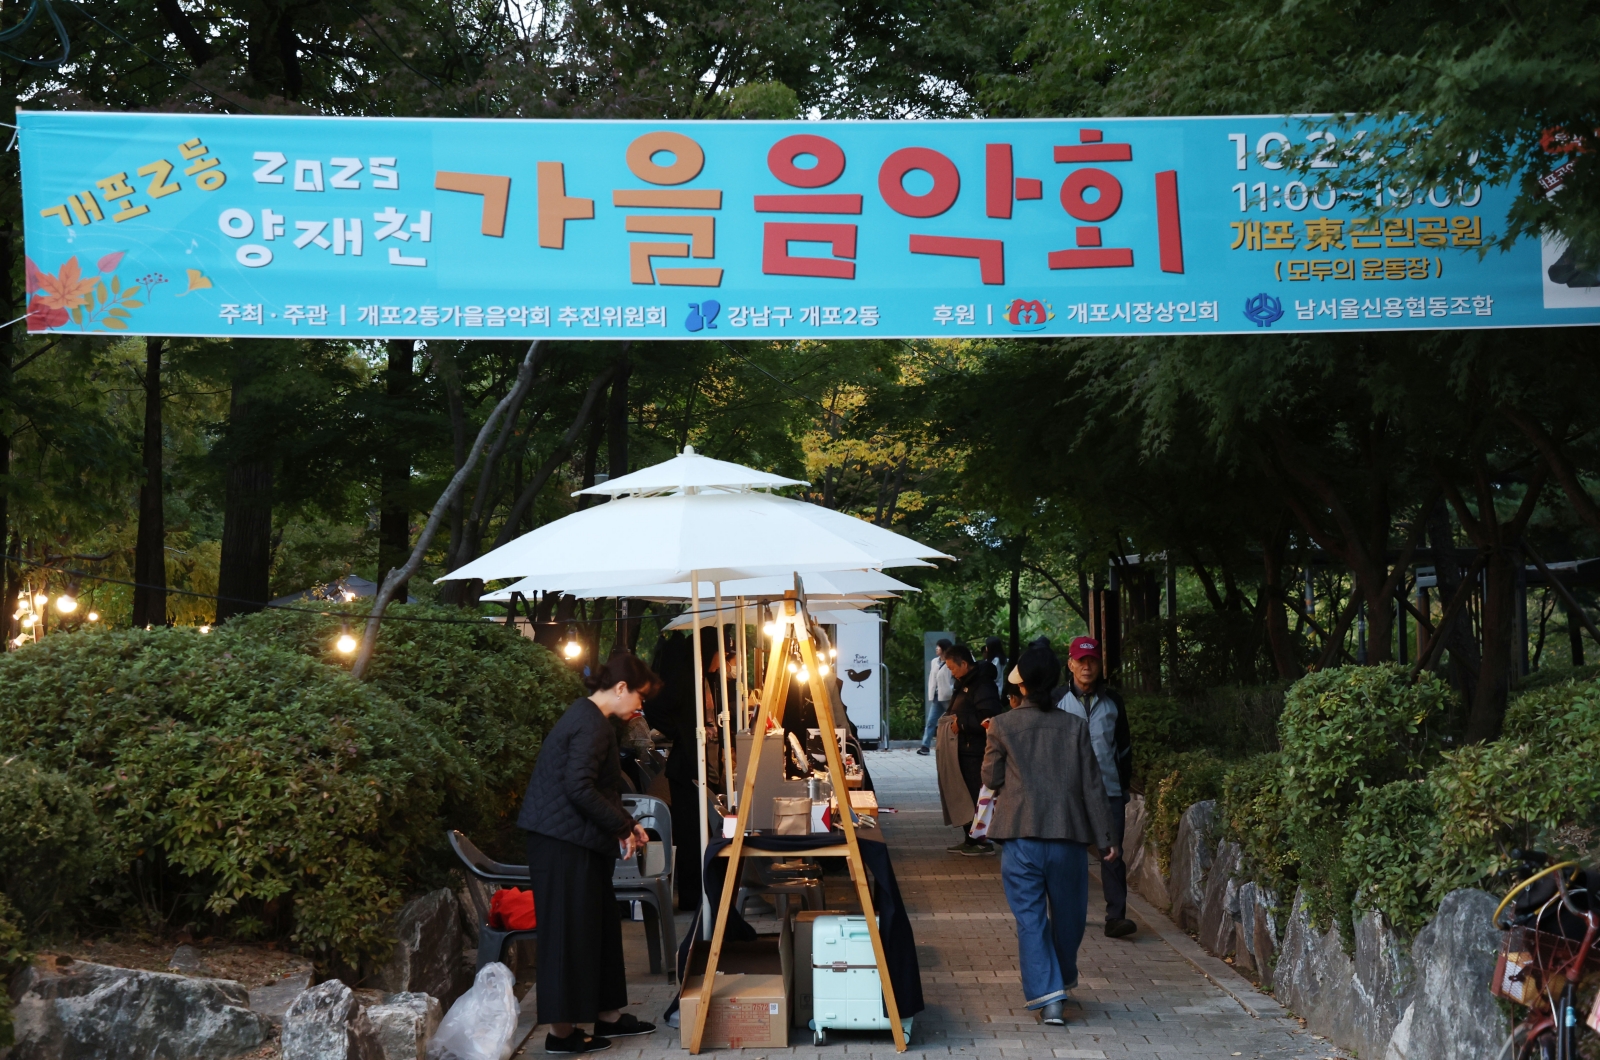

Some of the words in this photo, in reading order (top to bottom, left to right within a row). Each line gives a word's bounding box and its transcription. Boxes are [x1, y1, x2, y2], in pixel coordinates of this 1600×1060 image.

[252, 151, 399, 192] 2025
[218, 207, 433, 268] 양재천
[358, 305, 551, 328] 개포2동가을음악회
[557, 306, 667, 328] 추진위원회
[728, 306, 793, 328] 강남구
[799, 306, 880, 327] 개포2동
[933, 305, 976, 327] 후원
[1067, 301, 1220, 325] 개포시장상인회
[1294, 295, 1493, 321] 남서울신용협동조합
